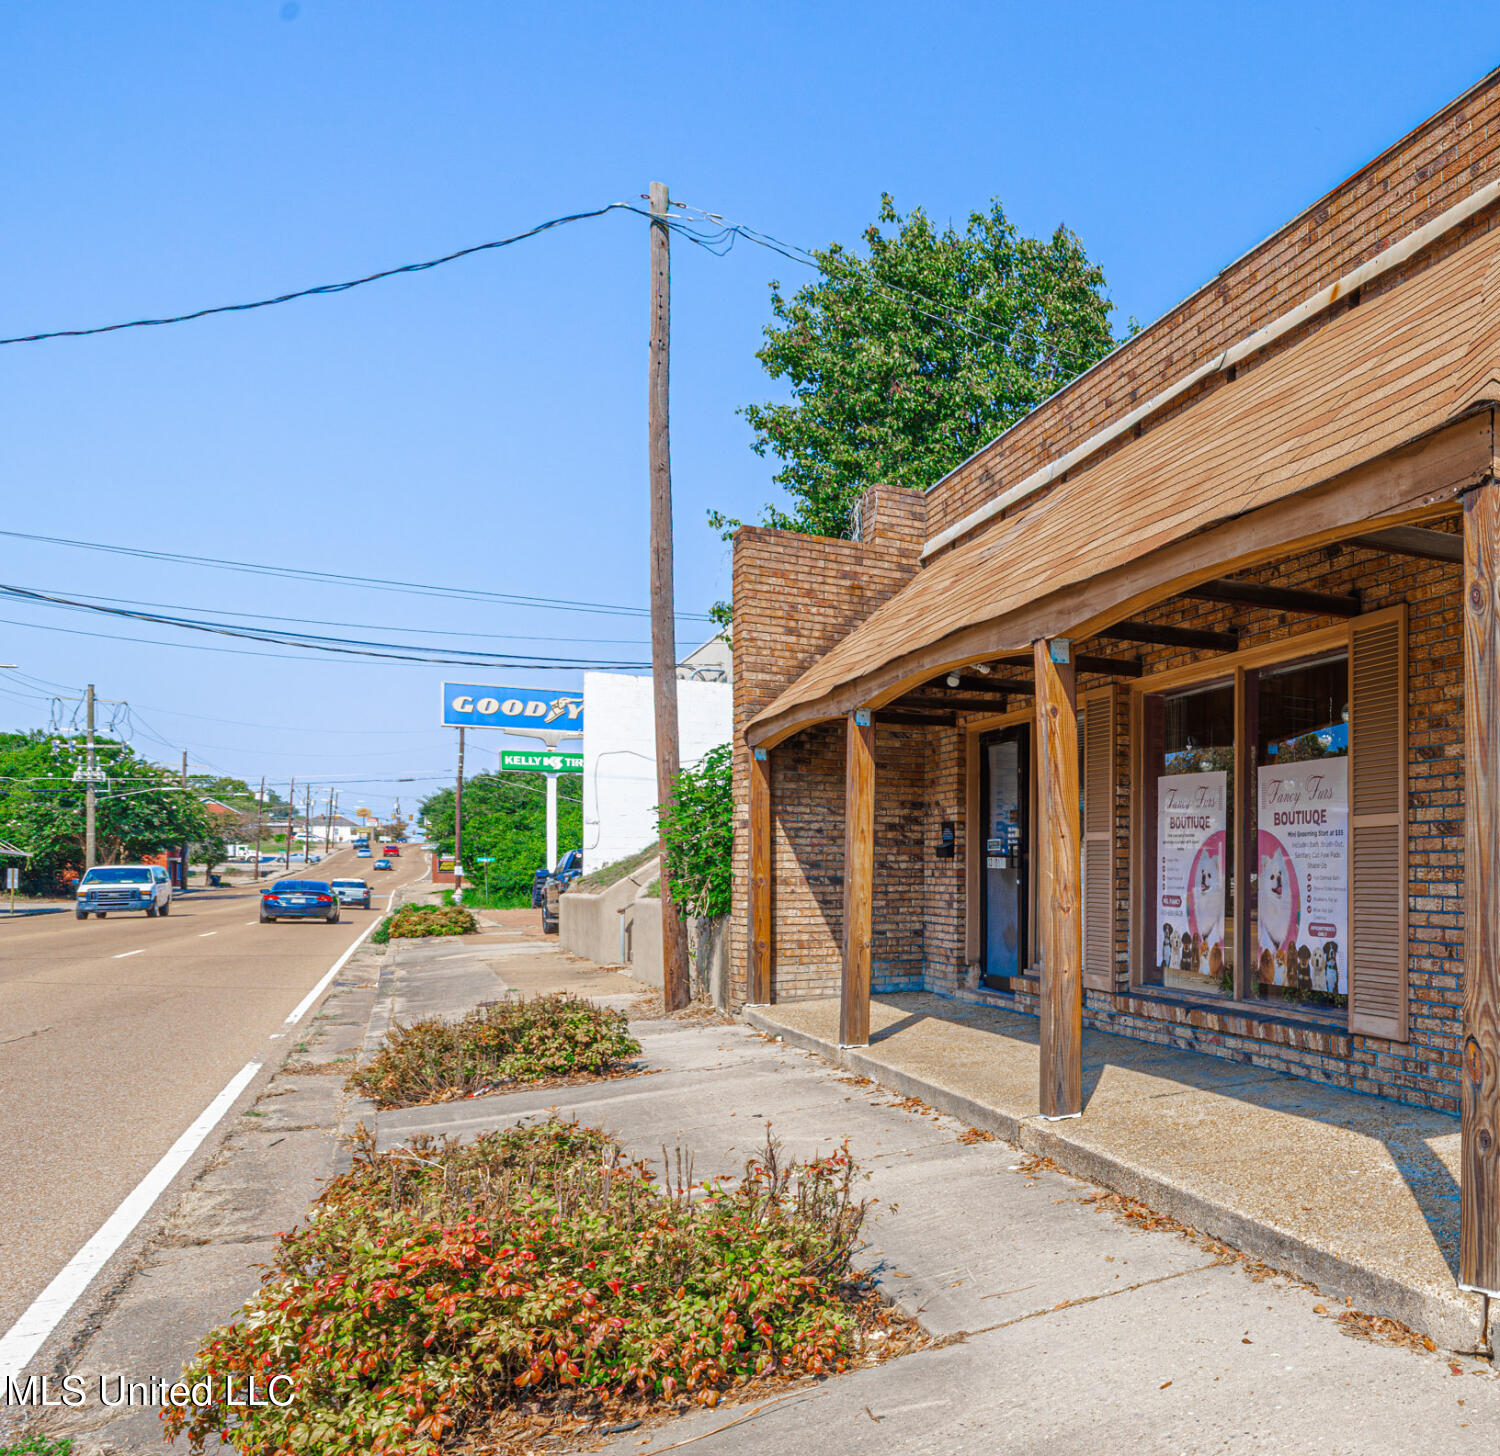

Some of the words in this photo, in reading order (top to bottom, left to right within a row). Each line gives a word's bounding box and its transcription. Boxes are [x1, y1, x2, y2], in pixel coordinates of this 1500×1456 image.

[504, 755, 541, 766] KELLY
[1268, 779, 1301, 811] Fancy
[1305, 774, 1333, 801] Furs
[1169, 815, 1211, 830] BOUTIUQE
[1273, 808, 1327, 827] BOUTIUQE
[1318, 829, 1329, 837] Start
